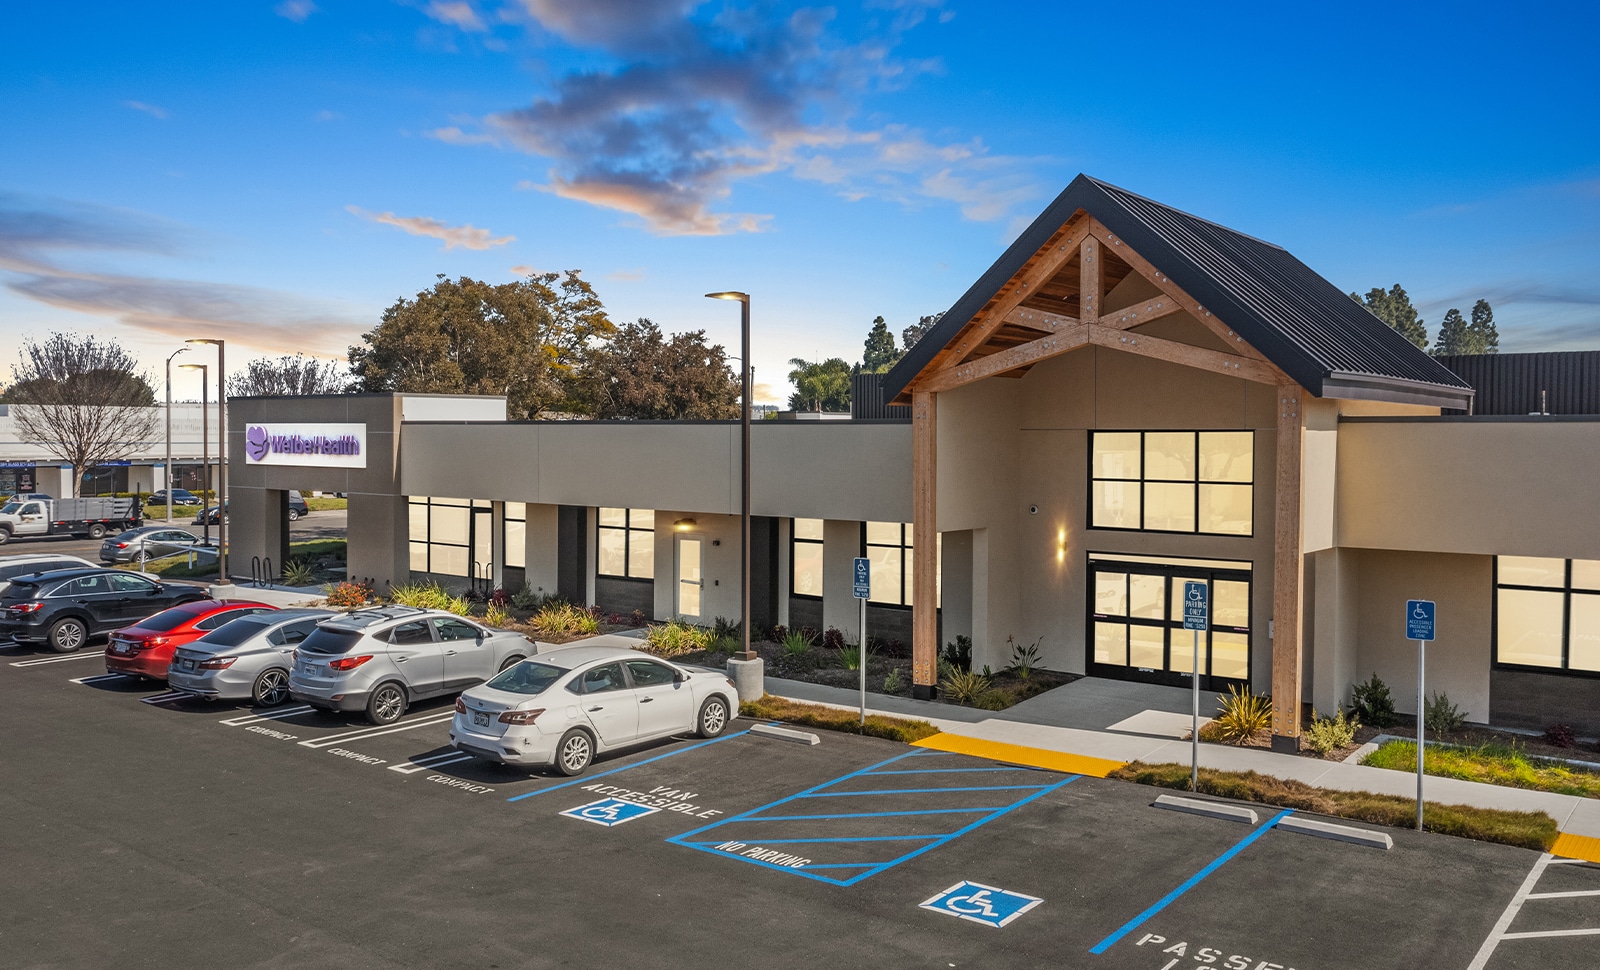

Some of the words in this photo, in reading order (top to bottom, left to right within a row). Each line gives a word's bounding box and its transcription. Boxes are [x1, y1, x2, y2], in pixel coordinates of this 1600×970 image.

[270, 434, 359, 455] WelbeHealth
[1185, 600, 1206, 608] PARKING
[245, 725, 298, 741] COMPACT
[327, 747, 388, 765] COMPACT
[426, 774, 495, 795] COMPACT
[648, 785, 699, 801] VAN
[580, 783, 724, 820] ACCESSIBLE
[714, 840, 746, 851] NO
[742, 846, 812, 869] PARKING
[1135, 933, 1296, 970] PASSE
